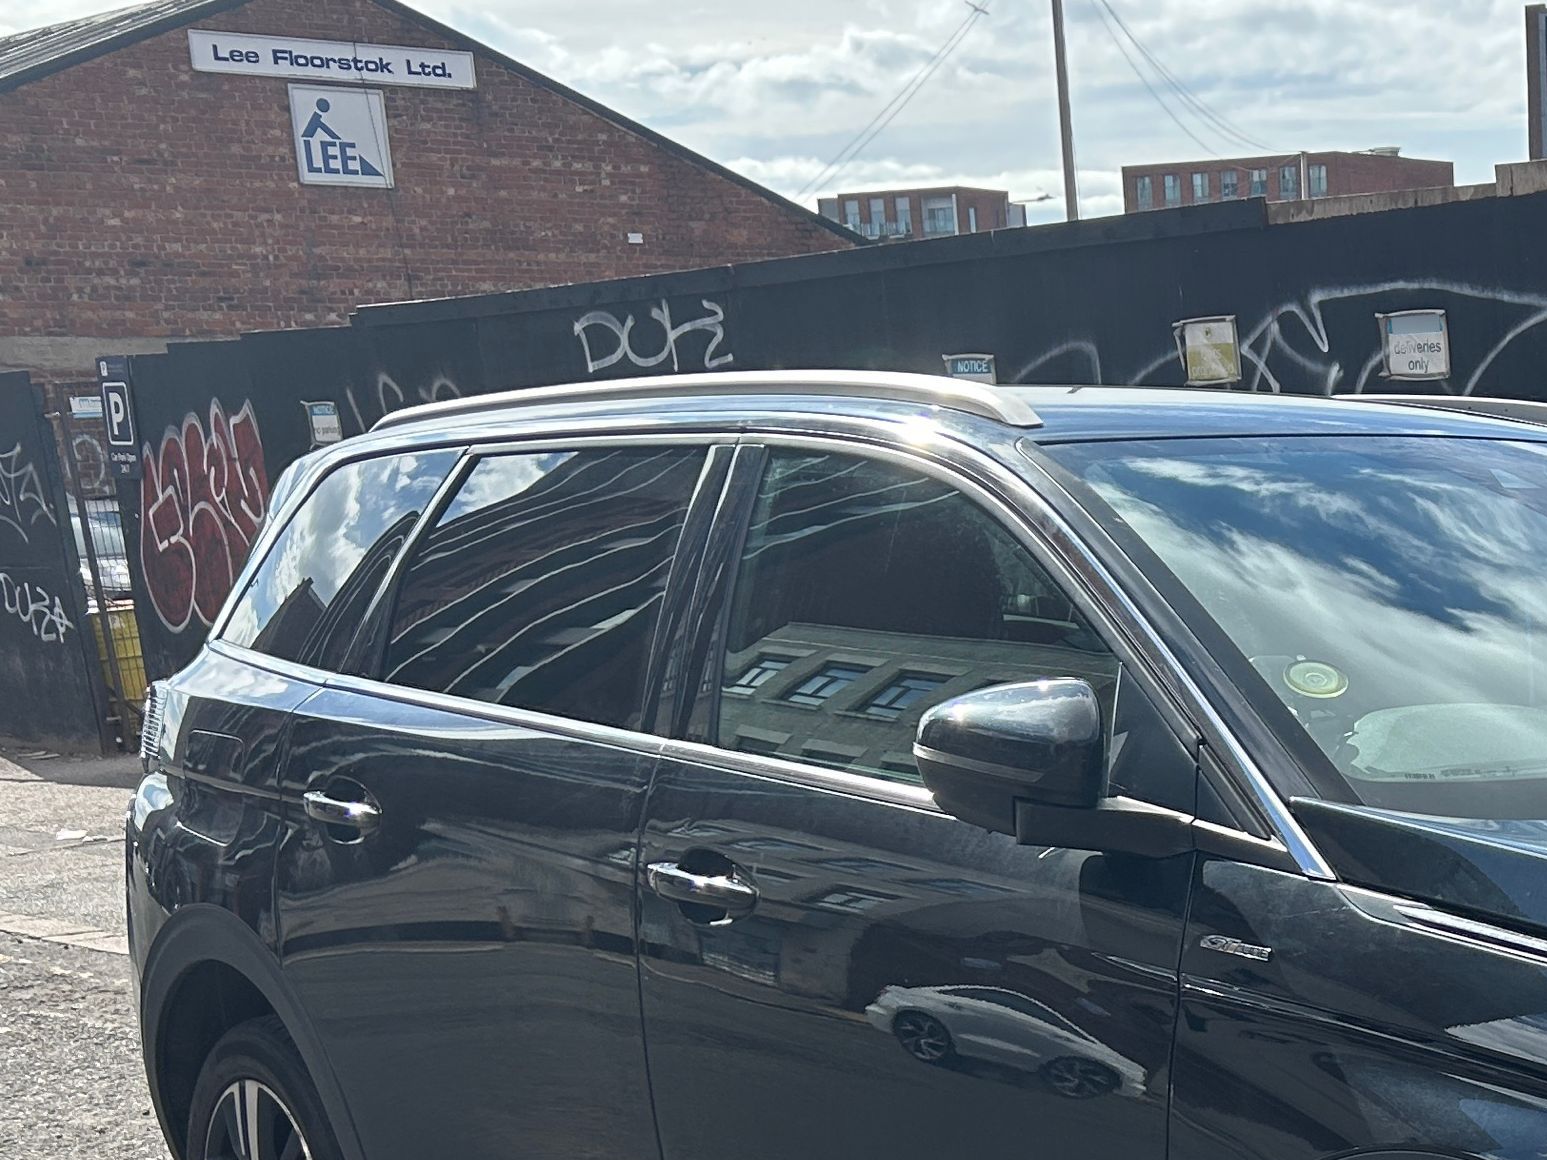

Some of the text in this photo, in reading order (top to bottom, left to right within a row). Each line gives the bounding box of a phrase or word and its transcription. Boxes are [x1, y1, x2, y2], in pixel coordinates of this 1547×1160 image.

[212, 44, 453, 79] Lee Floorstok Ltd.
[303, 139, 360, 176] LEE
[1394, 338, 1442, 355] deliveries
[957, 359, 988, 373] NOTICE
[1408, 357, 1429, 374] only
[108, 392, 125, 436] P
